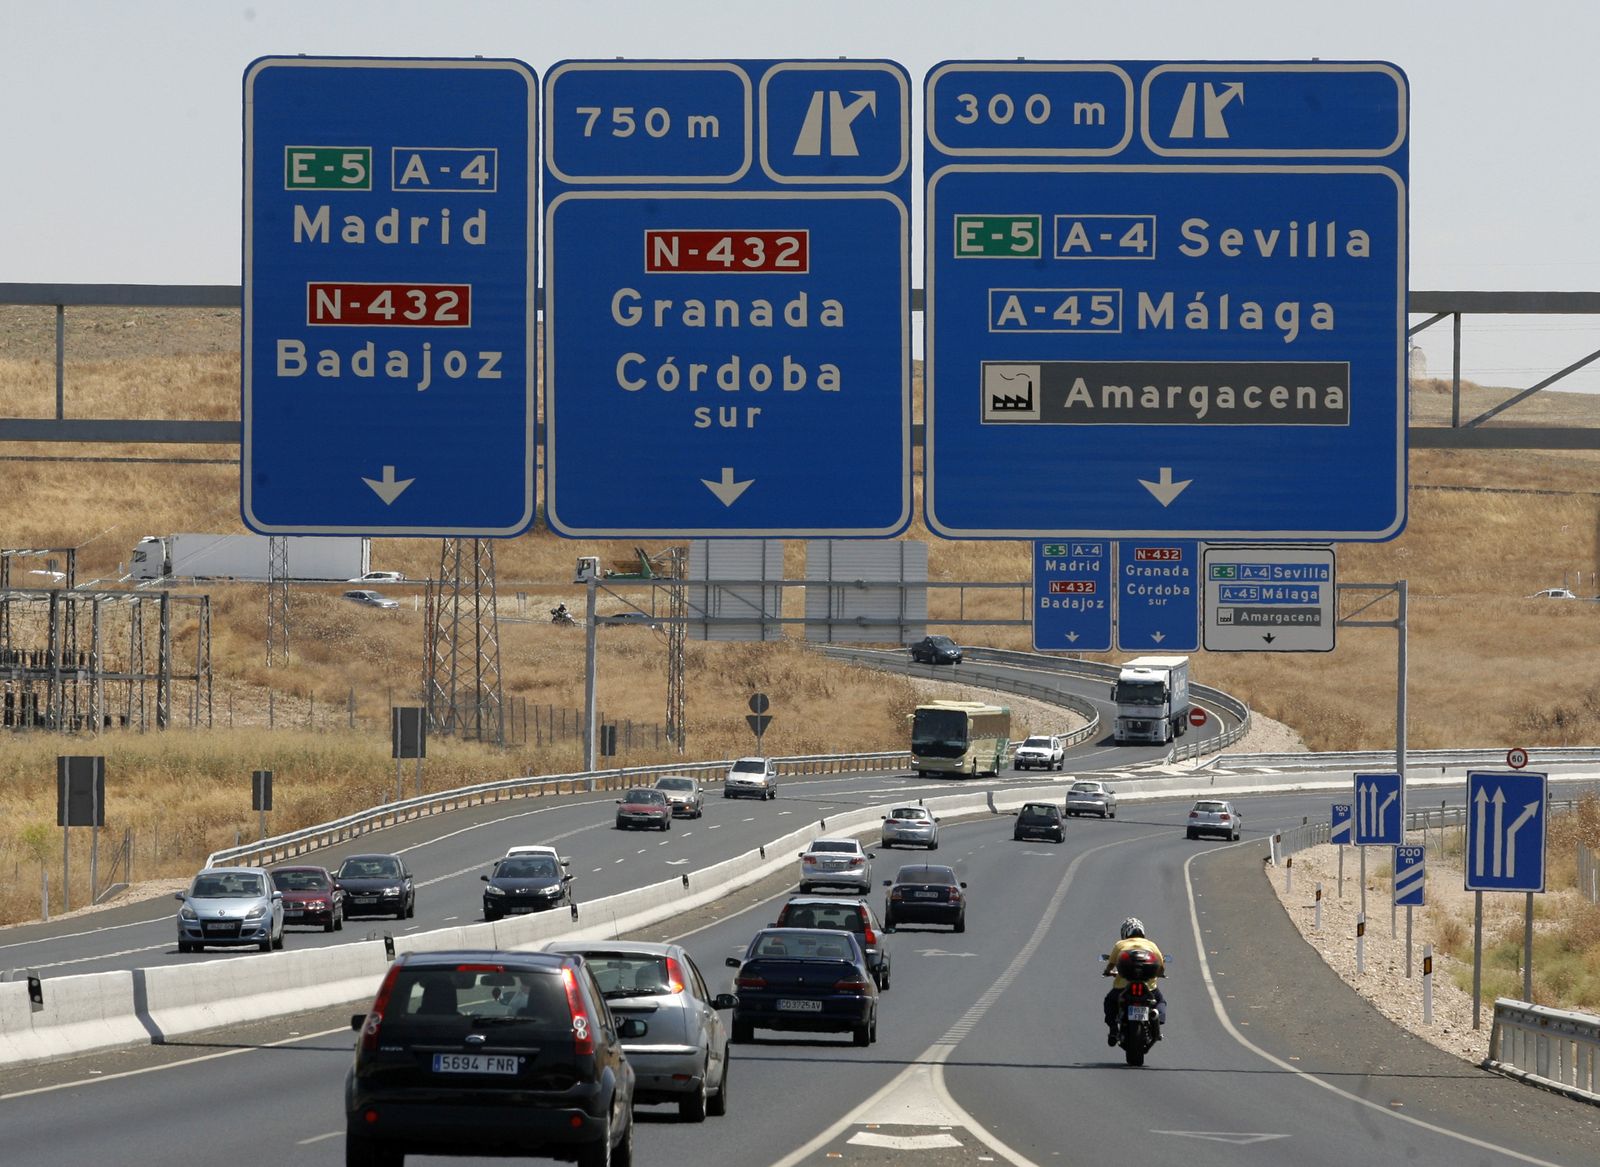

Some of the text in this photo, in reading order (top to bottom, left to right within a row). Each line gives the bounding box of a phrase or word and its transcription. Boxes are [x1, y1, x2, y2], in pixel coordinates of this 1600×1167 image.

[955, 94, 1105, 125] 300 m
[577, 107, 718, 138] 750 m
[293, 153, 488, 184] E-5 A-4
[294, 205, 486, 244] Madrid
[961, 218, 1369, 257] E-5 A-4 Sevilla
[655, 237, 799, 267] N-432
[316, 289, 459, 321] N-432
[612, 288, 843, 327] Granada
[998, 292, 1333, 343] A-45 Málaga
[277, 339, 502, 391] Badajoz
[616, 353, 840, 391] Córdoba
[1064, 378, 1343, 419] Amargacena
[694, 407, 761, 428] sur
[1044, 546, 1099, 555] E-5 A-4
[1137, 550, 1179, 559] N-432
[1045, 560, 1099, 571] Madrid
[1126, 565, 1189, 576] Granada
[1213, 567, 1328, 578] E-5 A-4 Sevilla
[1052, 583, 1093, 592] N-432
[1127, 583, 1190, 595] Córdoba
[1223, 587, 1318, 602] A-45 Málaga
[1041, 597, 1104, 612] Badajoz
[1148, 598, 1168, 606] sur
[1240, 611, 1320, 623] Amargacena
[1400, 848, 1420, 857] 200
[442, 1056, 514, 1072] 5694 FNR
